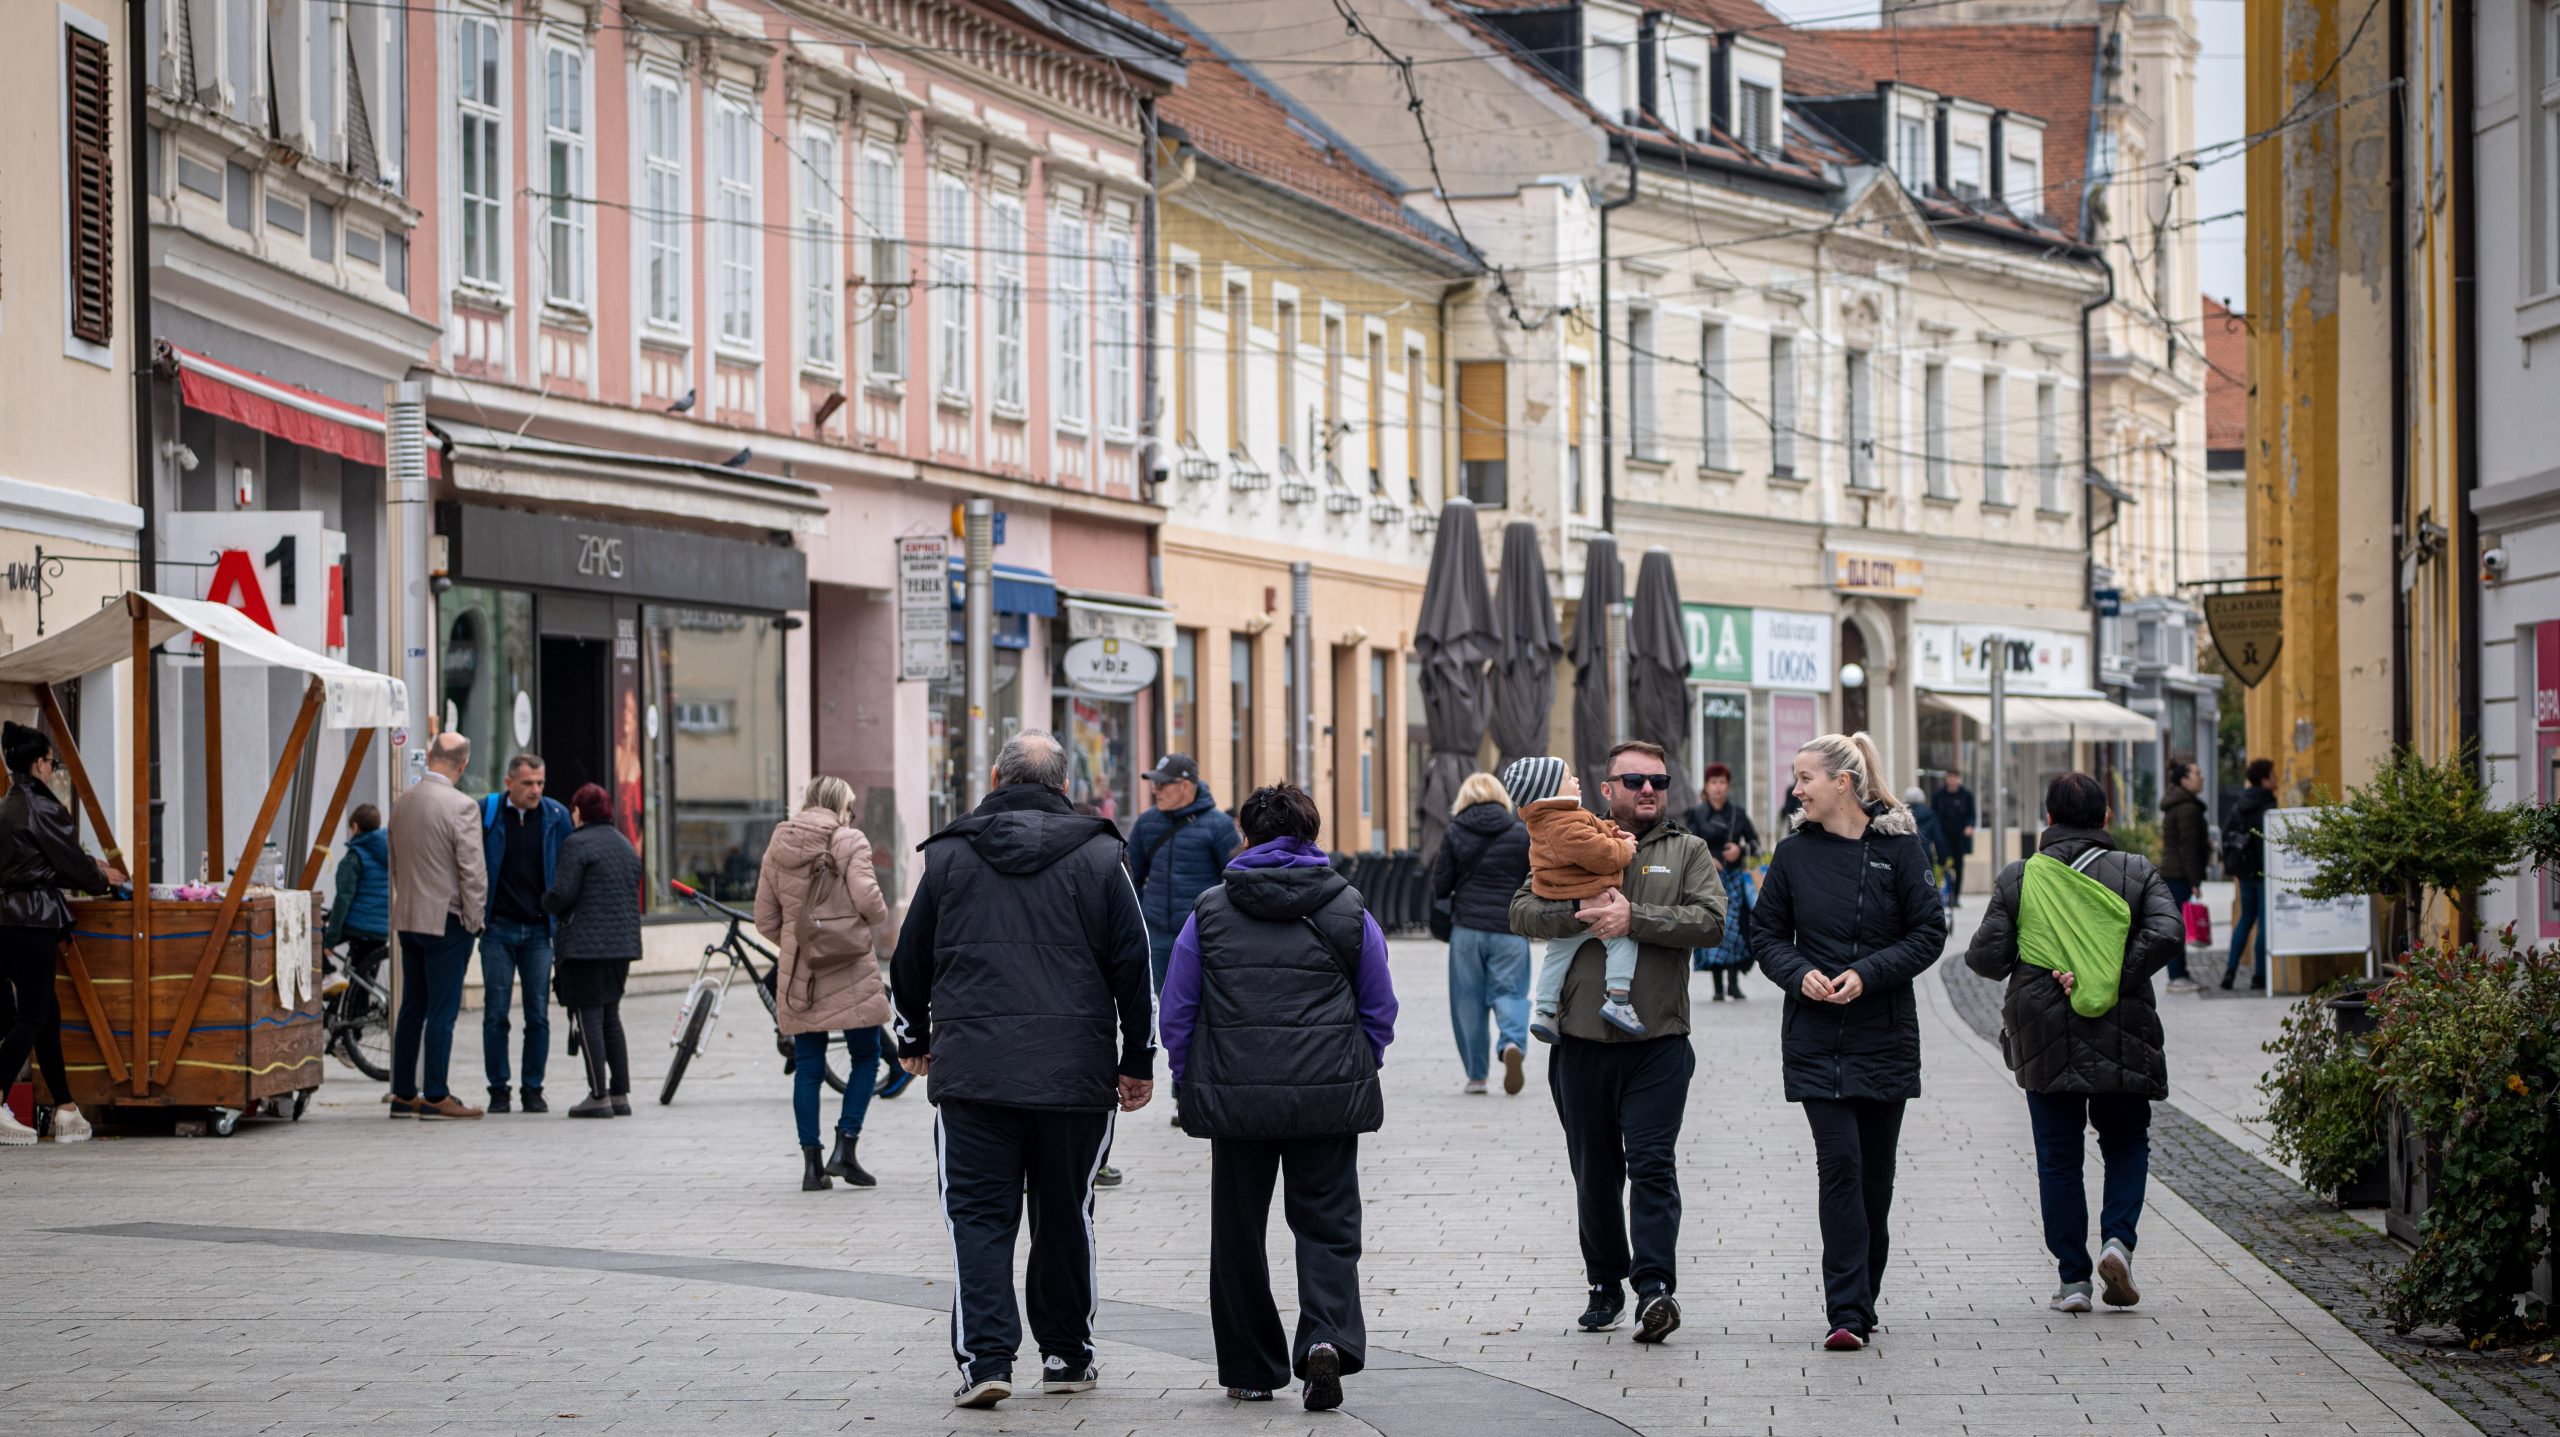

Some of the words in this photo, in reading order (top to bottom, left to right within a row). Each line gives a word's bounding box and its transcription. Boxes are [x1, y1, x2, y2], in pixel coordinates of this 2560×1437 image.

[577, 534, 624, 579] ZAKS
[1848, 558, 1869, 587] OLD
[1872, 560, 1895, 589] CITY
[192, 534, 296, 645] A1
[1768, 649, 1817, 682] LOGOS
[2539, 687, 2560, 721] BIPA
